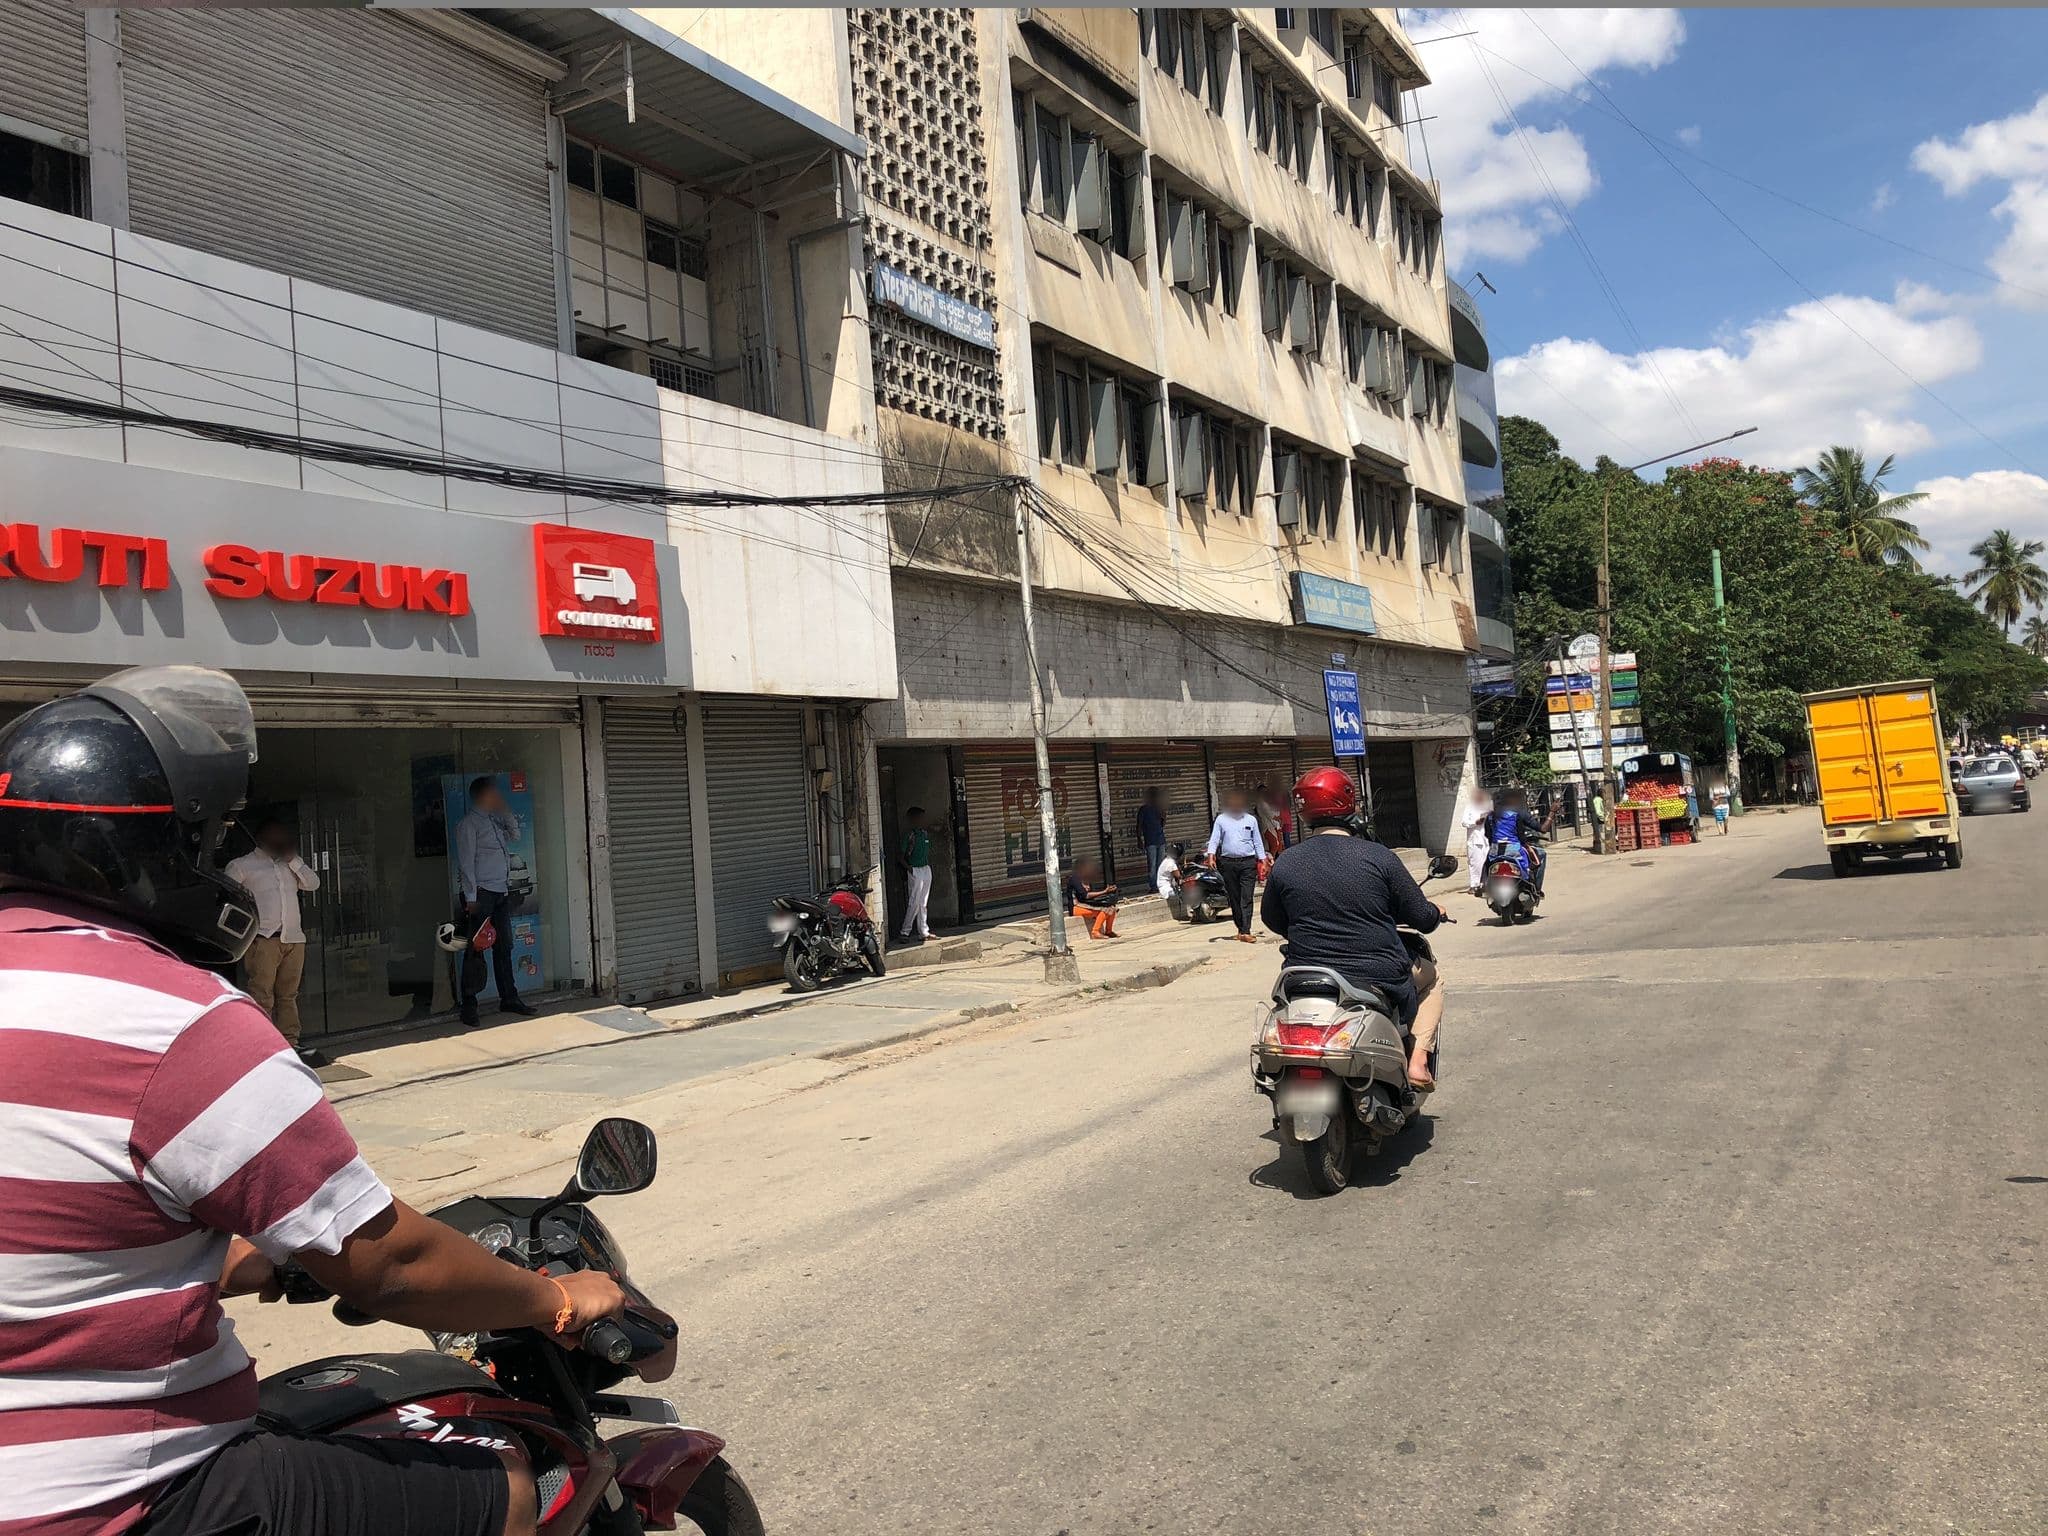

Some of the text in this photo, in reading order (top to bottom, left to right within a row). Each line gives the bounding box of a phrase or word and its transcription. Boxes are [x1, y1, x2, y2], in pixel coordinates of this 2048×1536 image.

[204, 543, 470, 617] SUZUKI
[557, 610, 656, 631] COMMERCIAL
[1624, 761, 1639, 773] 80
[1659, 754, 1675, 766] 70
[1001, 777, 1068, 820] FOD
